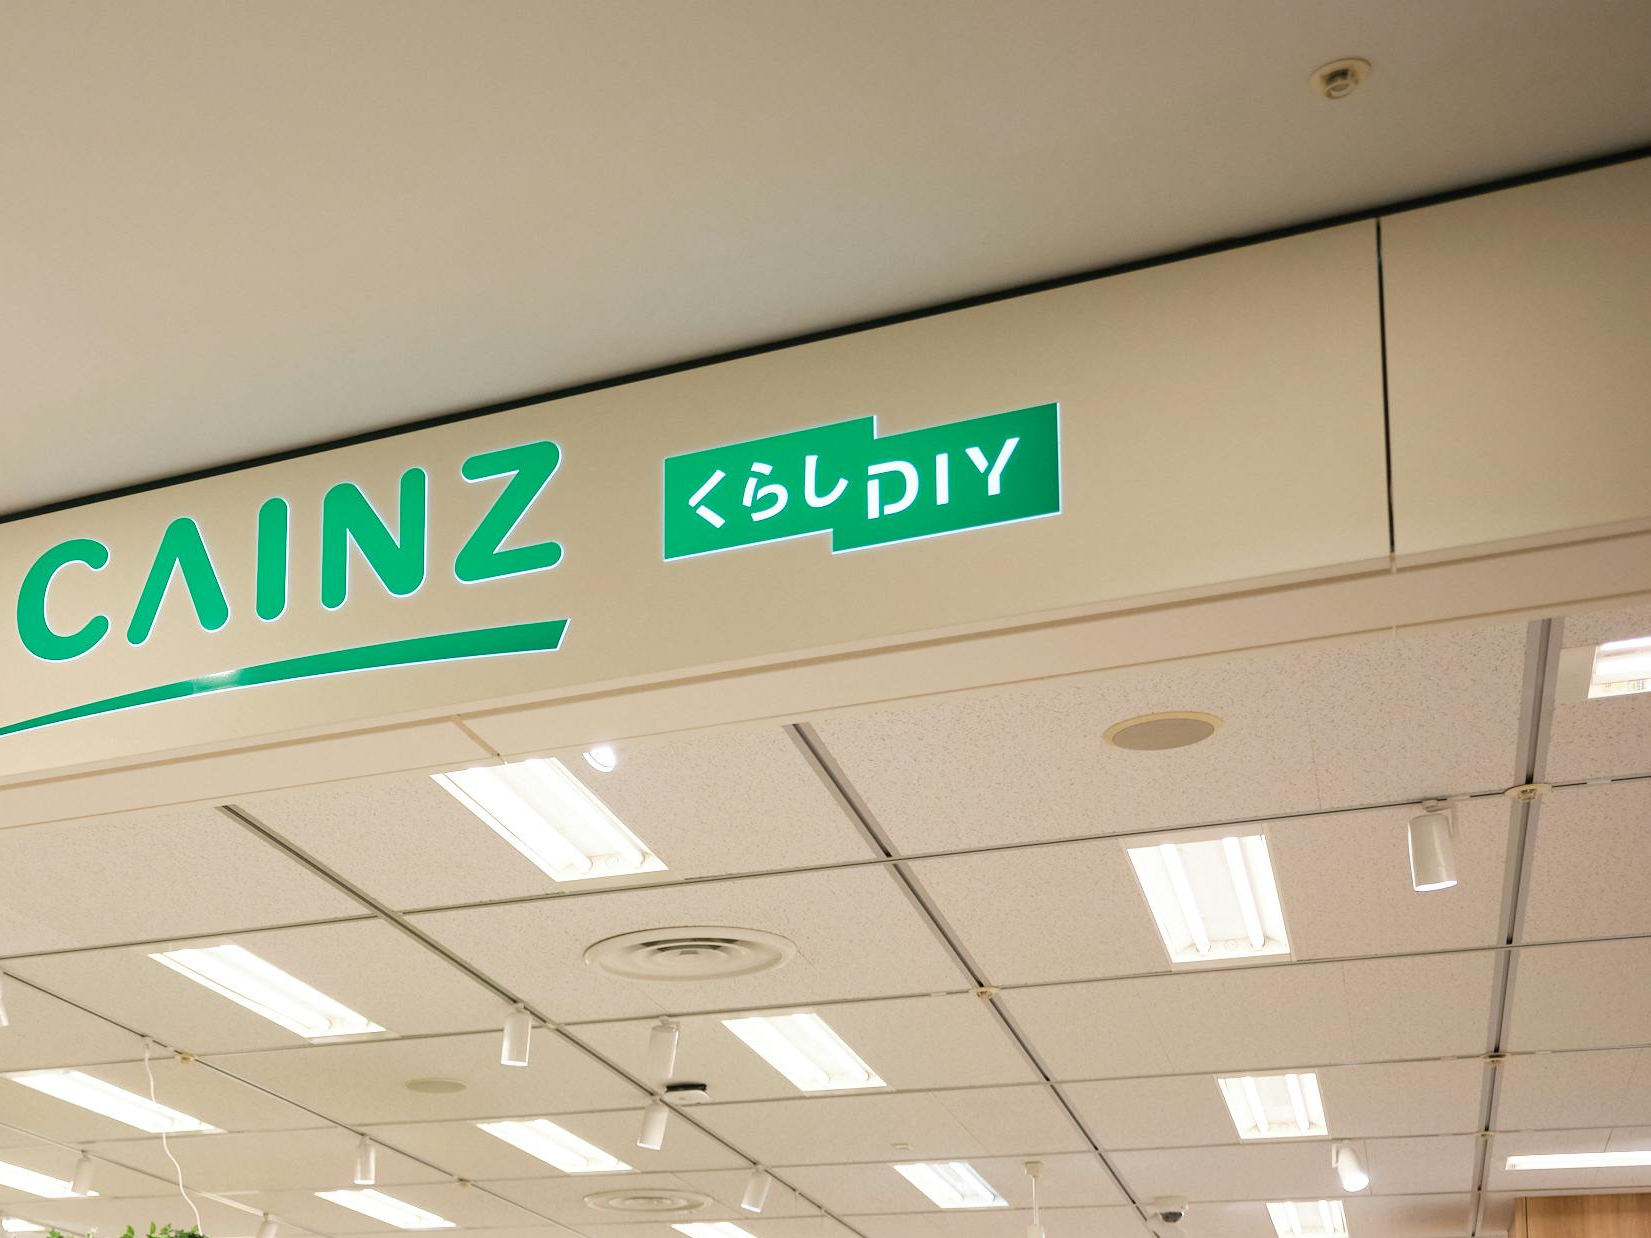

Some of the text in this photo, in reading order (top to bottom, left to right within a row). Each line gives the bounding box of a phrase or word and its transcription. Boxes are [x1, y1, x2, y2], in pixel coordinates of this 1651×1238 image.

[16, 440, 564, 662] CAINZ
[687, 435, 1020, 529] くらし DIY
